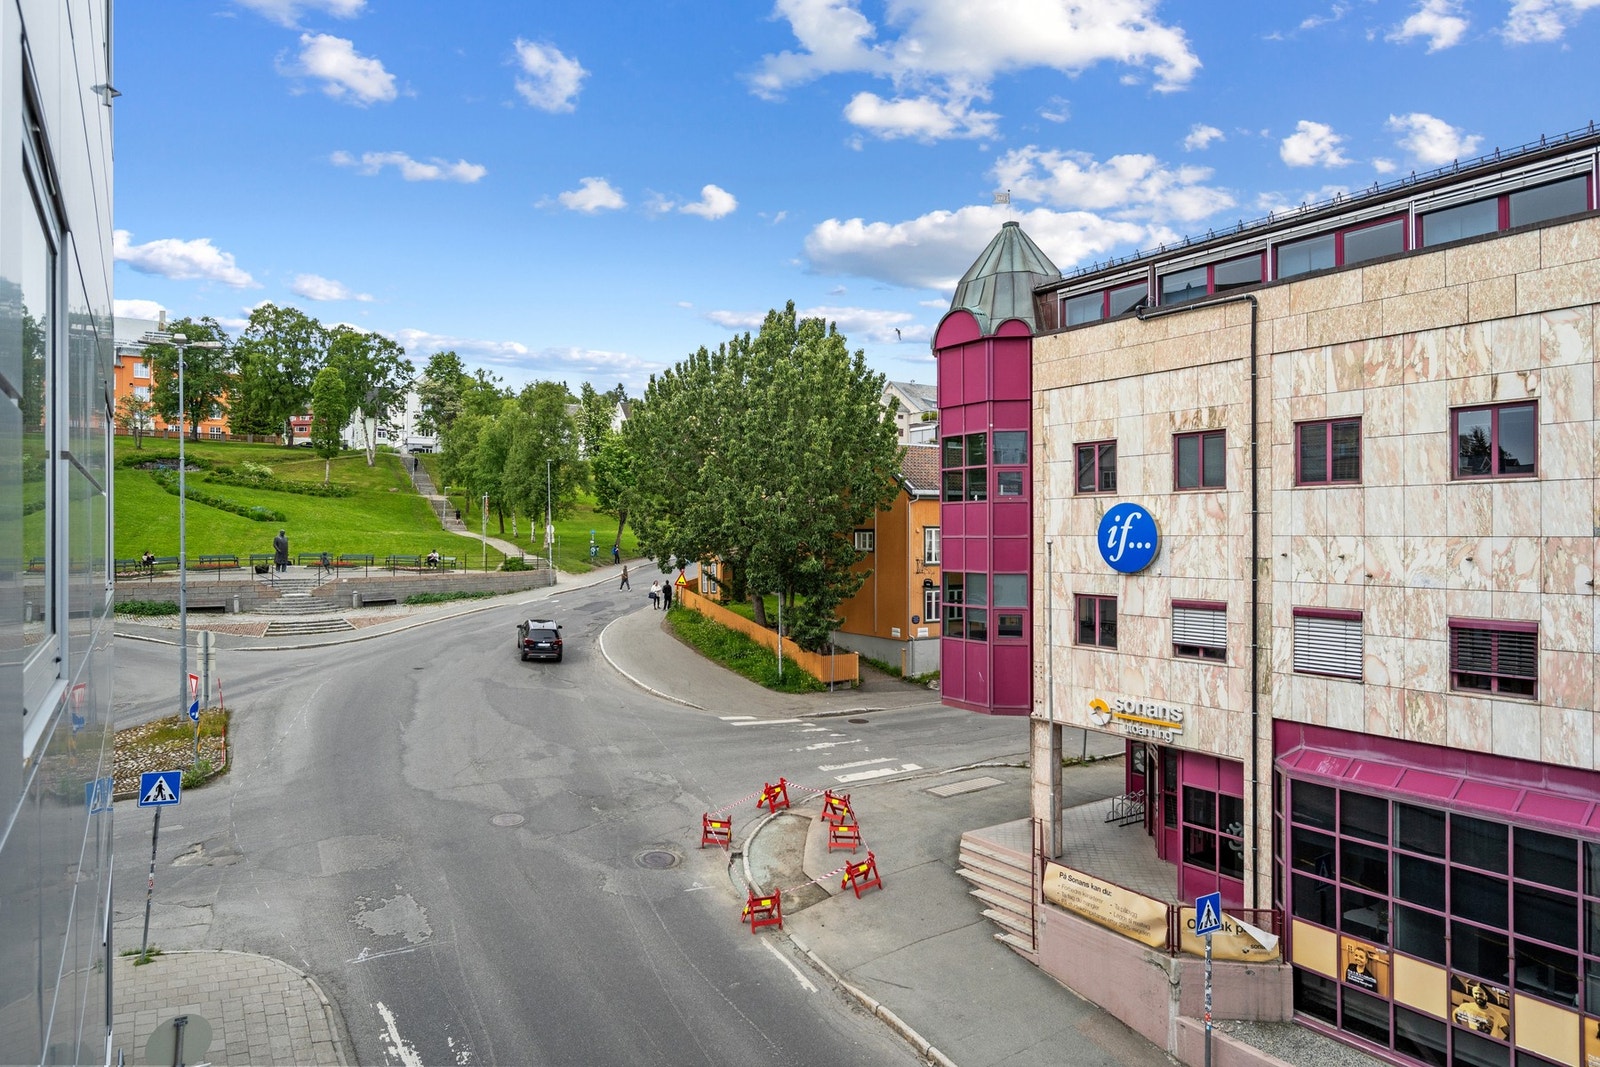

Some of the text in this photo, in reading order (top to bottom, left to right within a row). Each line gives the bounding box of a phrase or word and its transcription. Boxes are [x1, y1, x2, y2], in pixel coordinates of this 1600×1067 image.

[1115, 697, 1184, 722] sonans
[1059, 871, 1067, 880] På
[1068, 874, 1090, 888] Sonans
[1090, 882, 1102, 893] kan
